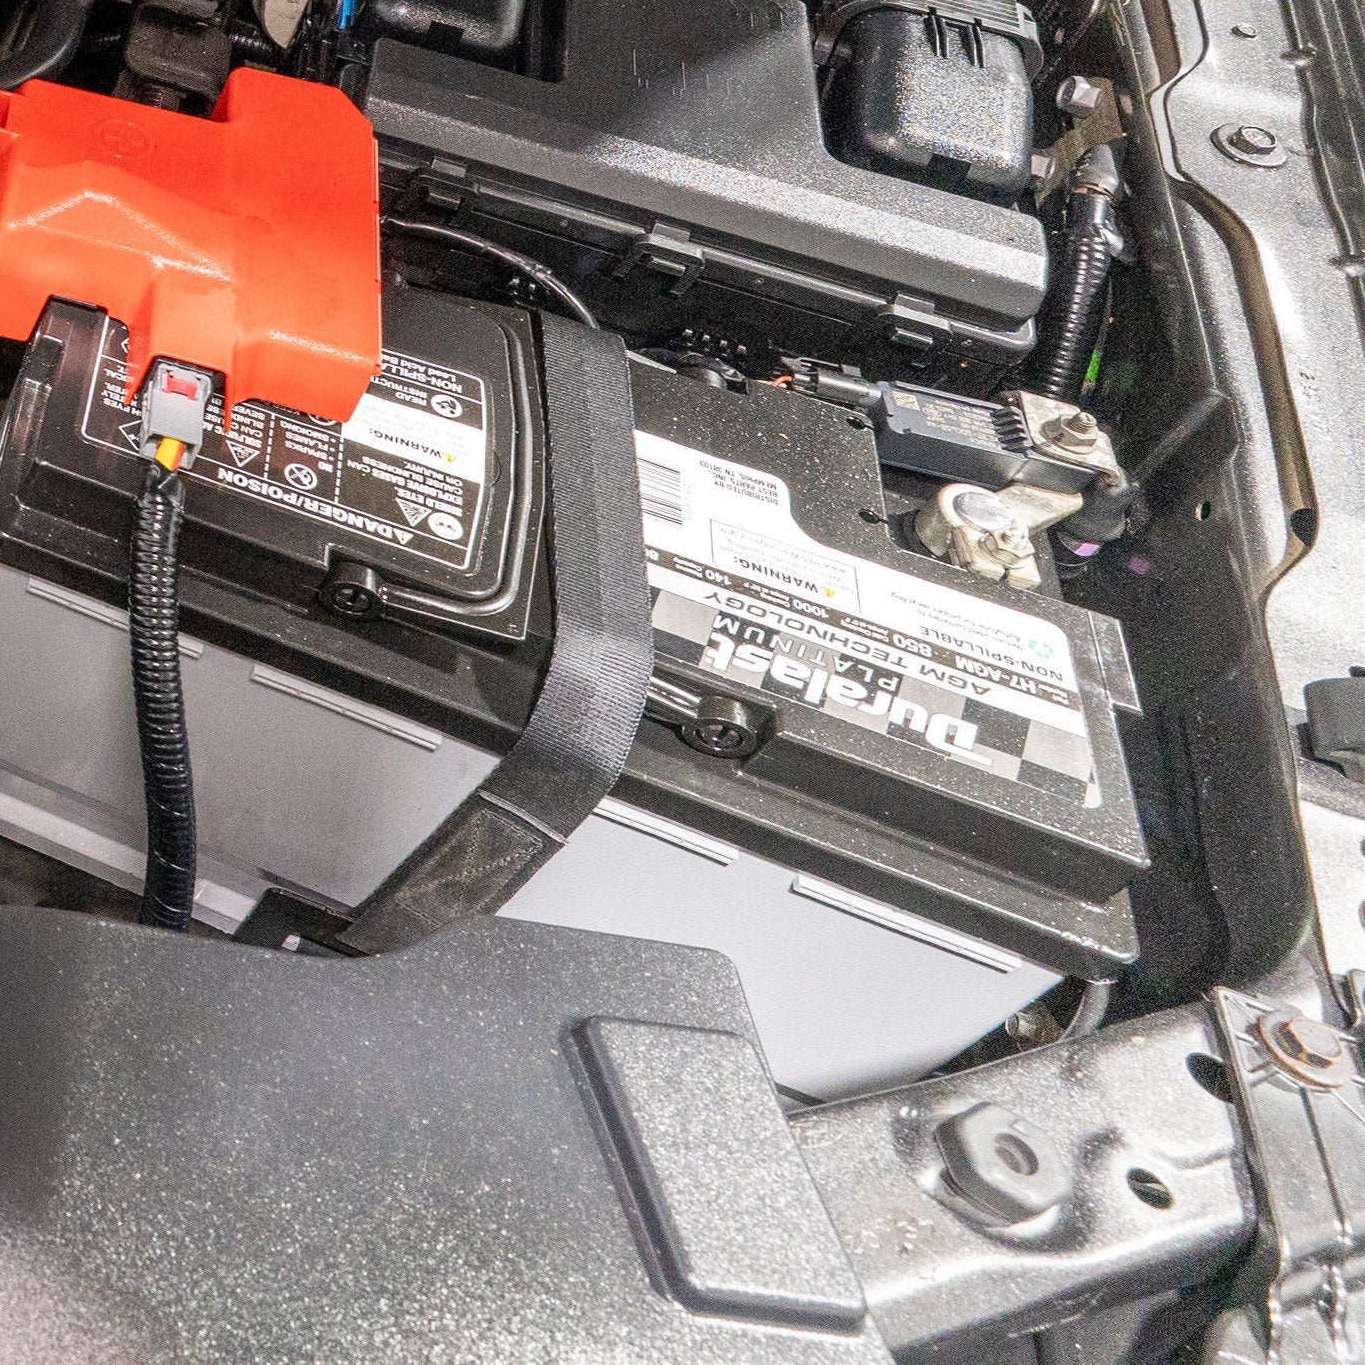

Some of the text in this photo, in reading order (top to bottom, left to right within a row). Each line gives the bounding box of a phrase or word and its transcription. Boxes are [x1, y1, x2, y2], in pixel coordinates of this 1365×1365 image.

[397, 357, 427, 374] Acid
[426, 366, 457, 382] Lead
[101, 396, 131, 413] EYES
[394, 389, 427, 407] READ
[203, 412, 263, 437] CAN CUSE
[279, 419, 329, 443] SMOKING
[284, 429, 328, 451] FLAMES
[284, 438, 327, 460] SPARKS
[368, 426, 442, 459] WARNING:
[345, 459, 371, 474] CAN
[361, 455, 463, 496] CAUSE BLINDNESS
[723, 467, 736, 477] TN
[405, 478, 462, 505] EXPLOSIVE
[443, 474, 463, 488] OR
[712, 478, 780, 506] DISTRIBUTED BY
[756, 485, 779, 497] BEST
[215, 467, 394, 540] DANGER/POISON
[702, 568, 733, 586] 140
[731, 555, 821, 594] WARNING:
[790, 597, 831, 619] 1000
[703, 591, 989, 696] AGM TECHNOLOGY
[711, 614, 899, 691] PLATINUM
[917, 624, 1064, 682] NON-SPILLABLE
[890, 632, 1034, 691] H7-AGM 850
[700, 630, 993, 766] Duralast
